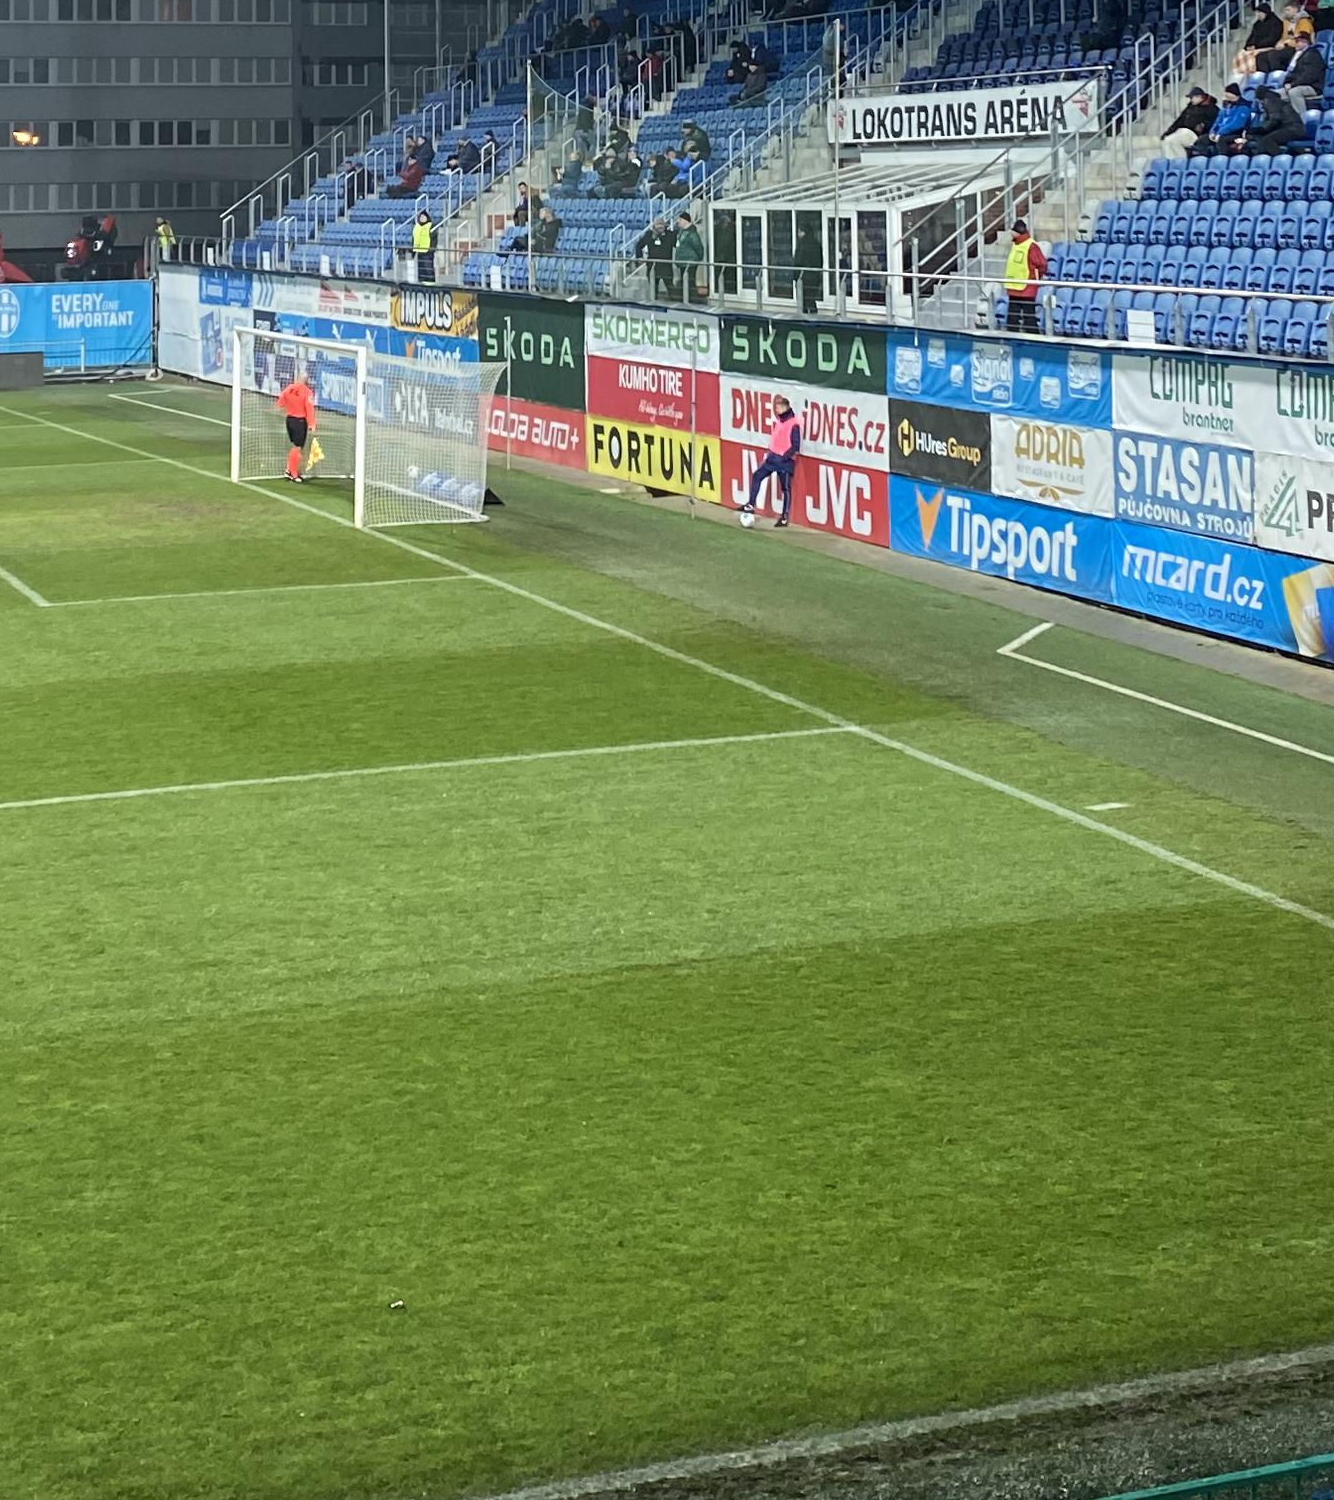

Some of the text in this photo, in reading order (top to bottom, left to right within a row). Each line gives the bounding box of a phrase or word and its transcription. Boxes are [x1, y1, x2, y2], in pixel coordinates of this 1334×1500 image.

[851, 88, 1068, 140] LOKOTRANS ARÉNA
[57, 311, 135, 329] IMPORTANT
[399, 290, 454, 331] IMPULS
[591, 306, 711, 354] ŠKOENERGO
[618, 363, 683, 398] KUMHO TIRE
[802, 399, 886, 454] iDNES.cz
[1014, 423, 1085, 469] ADRIA
[1182, 407, 1234, 433] brantner
[593, 423, 716, 492] FORTUNA
[1118, 437, 1252, 514] STASAN
[805, 464, 873, 537] JVC
[946, 495, 1078, 582] Tipsport
[1121, 543, 1265, 611] mcard.cz
